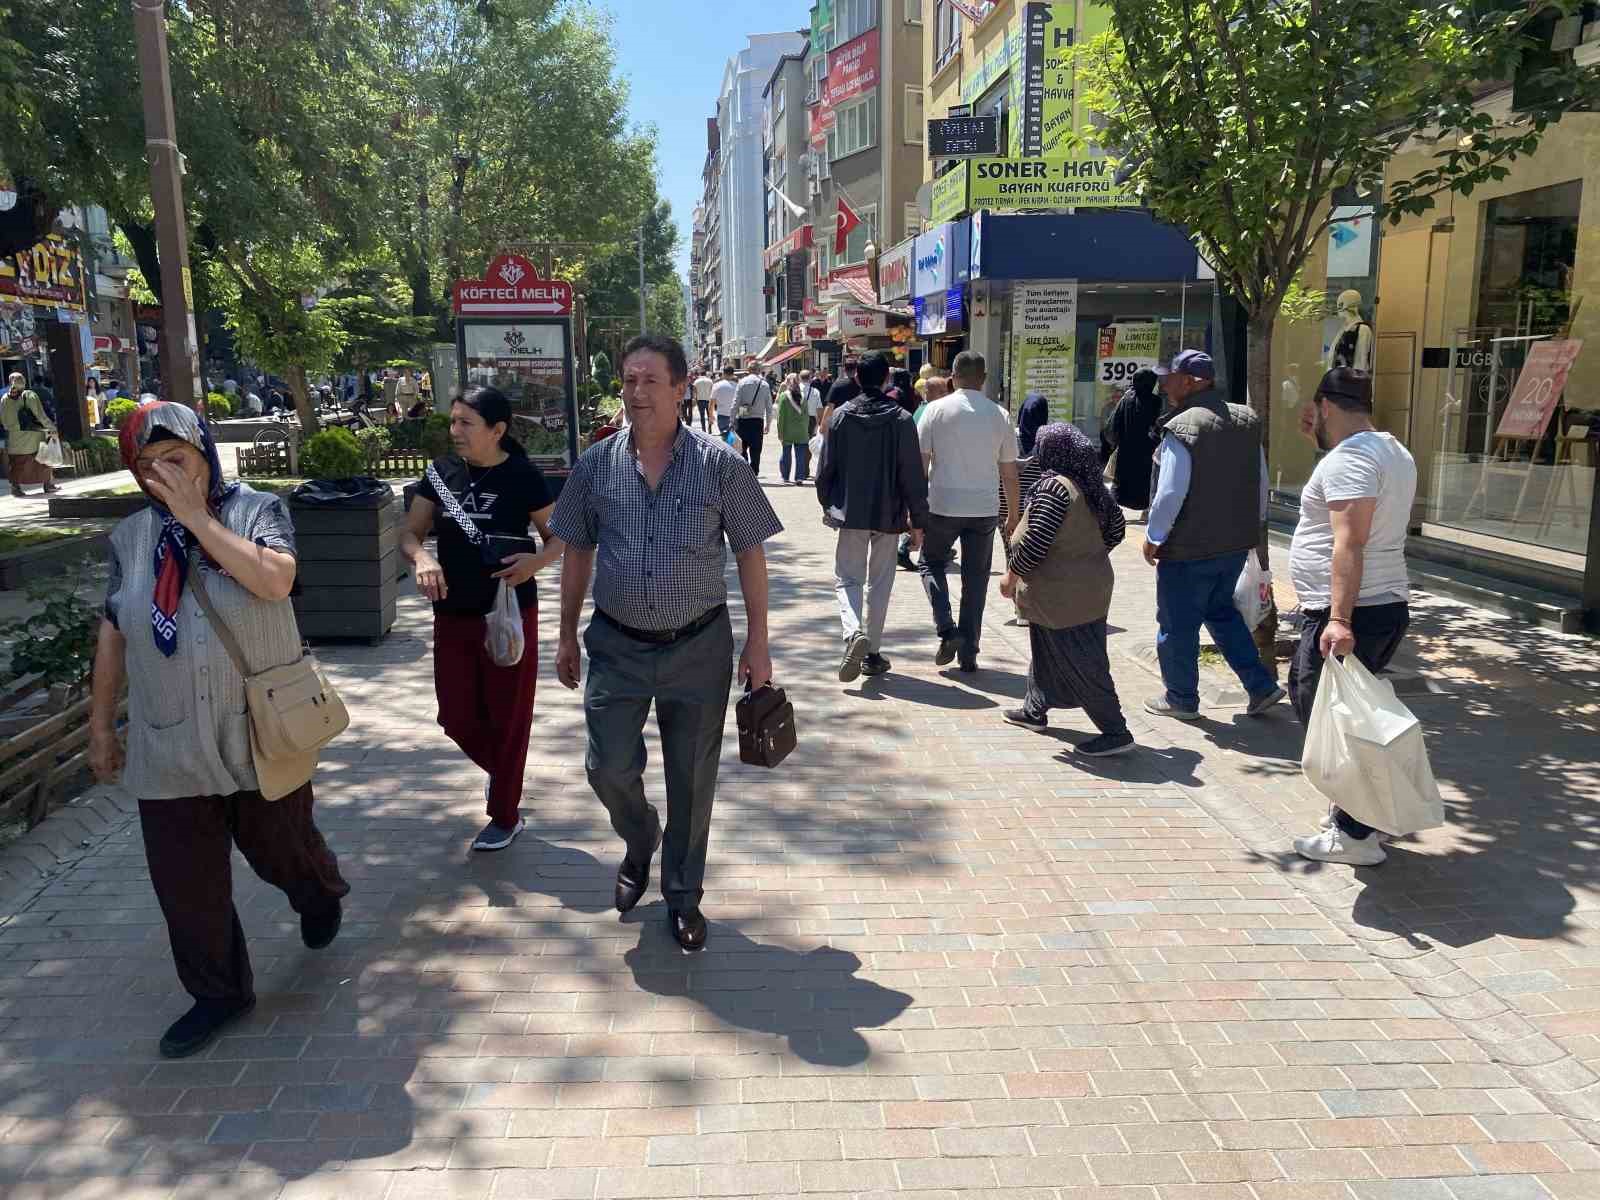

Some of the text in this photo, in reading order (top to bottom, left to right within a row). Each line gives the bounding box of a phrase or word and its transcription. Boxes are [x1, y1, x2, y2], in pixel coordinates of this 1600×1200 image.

[1043, 87, 1074, 100] HAVVA
[1044, 107, 1072, 132] BAYAN
[976, 162, 1048, 179] SONER
[1063, 161, 1107, 179] HAV
[999, 182, 1043, 194] BAYAN
[460, 286, 565, 300] KÖFTECİ MELİH
